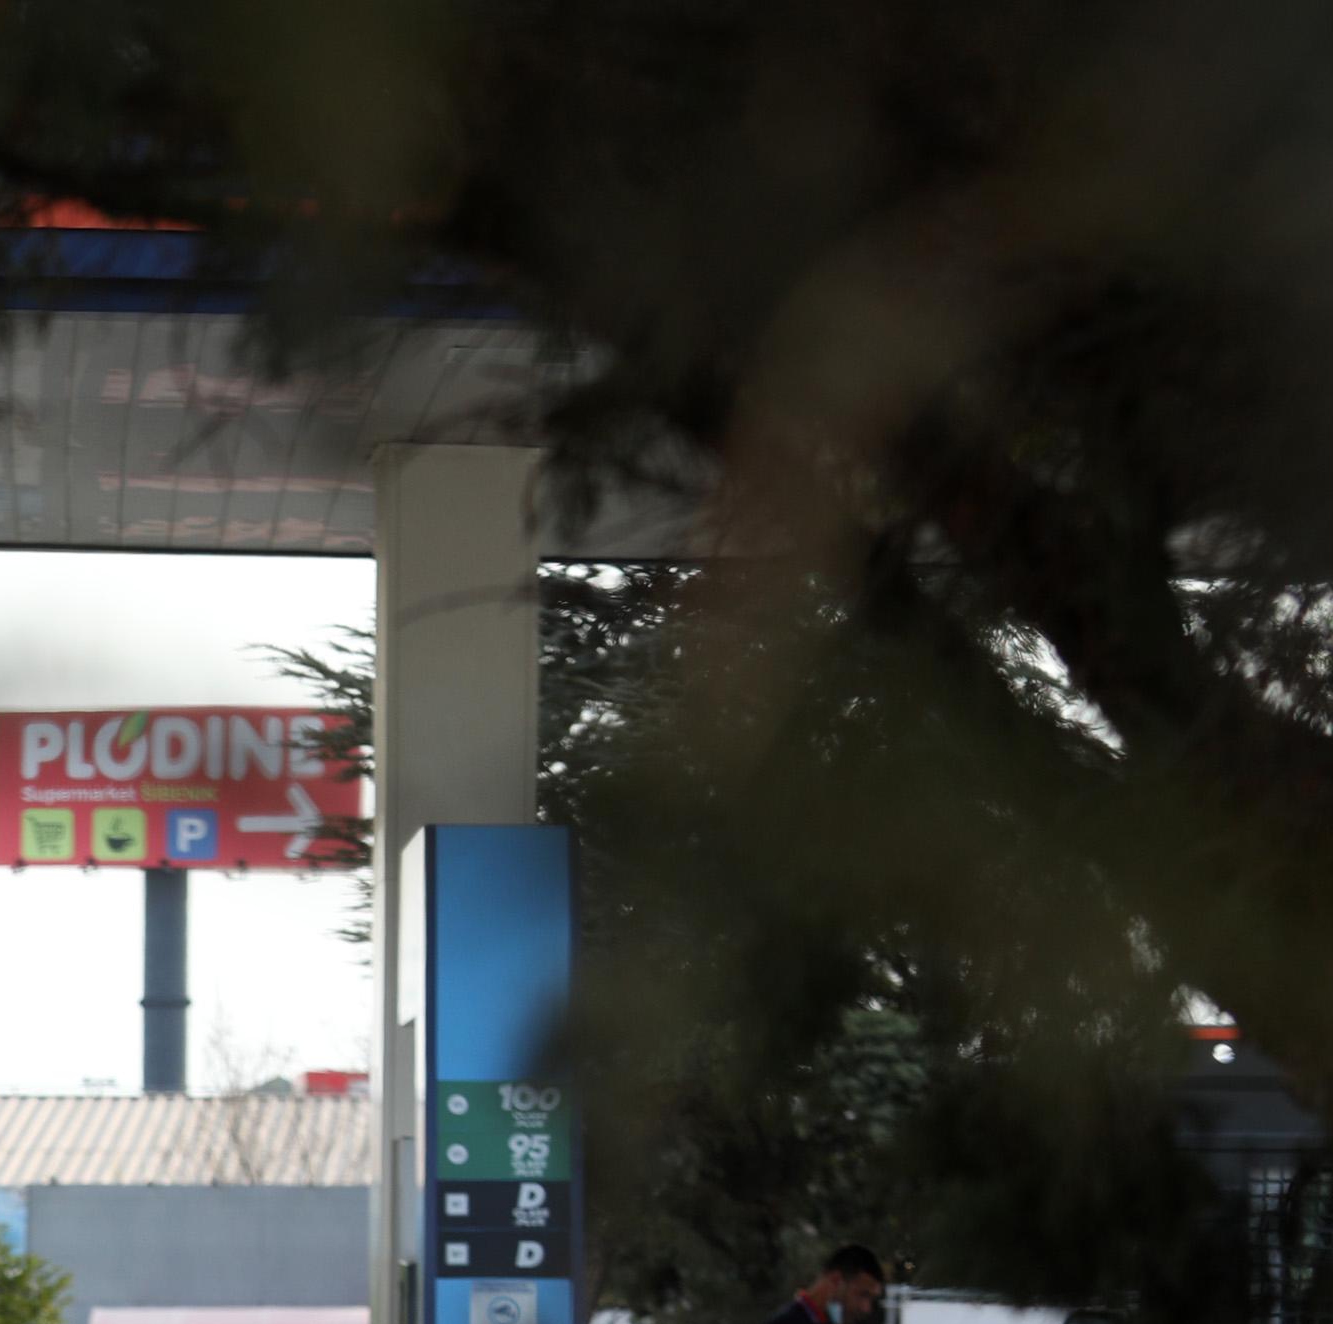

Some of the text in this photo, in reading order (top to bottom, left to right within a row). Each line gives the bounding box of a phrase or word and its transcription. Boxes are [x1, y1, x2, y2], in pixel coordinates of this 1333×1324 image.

[20, 713, 327, 780] PLODINE
[21, 785, 136, 803] Supermarket
[176, 816, 209, 853] P
[498, 1084, 561, 1112] 100
[508, 1134, 551, 1161] 95
[517, 1183, 546, 1209] D
[515, 1240, 545, 1268] D
